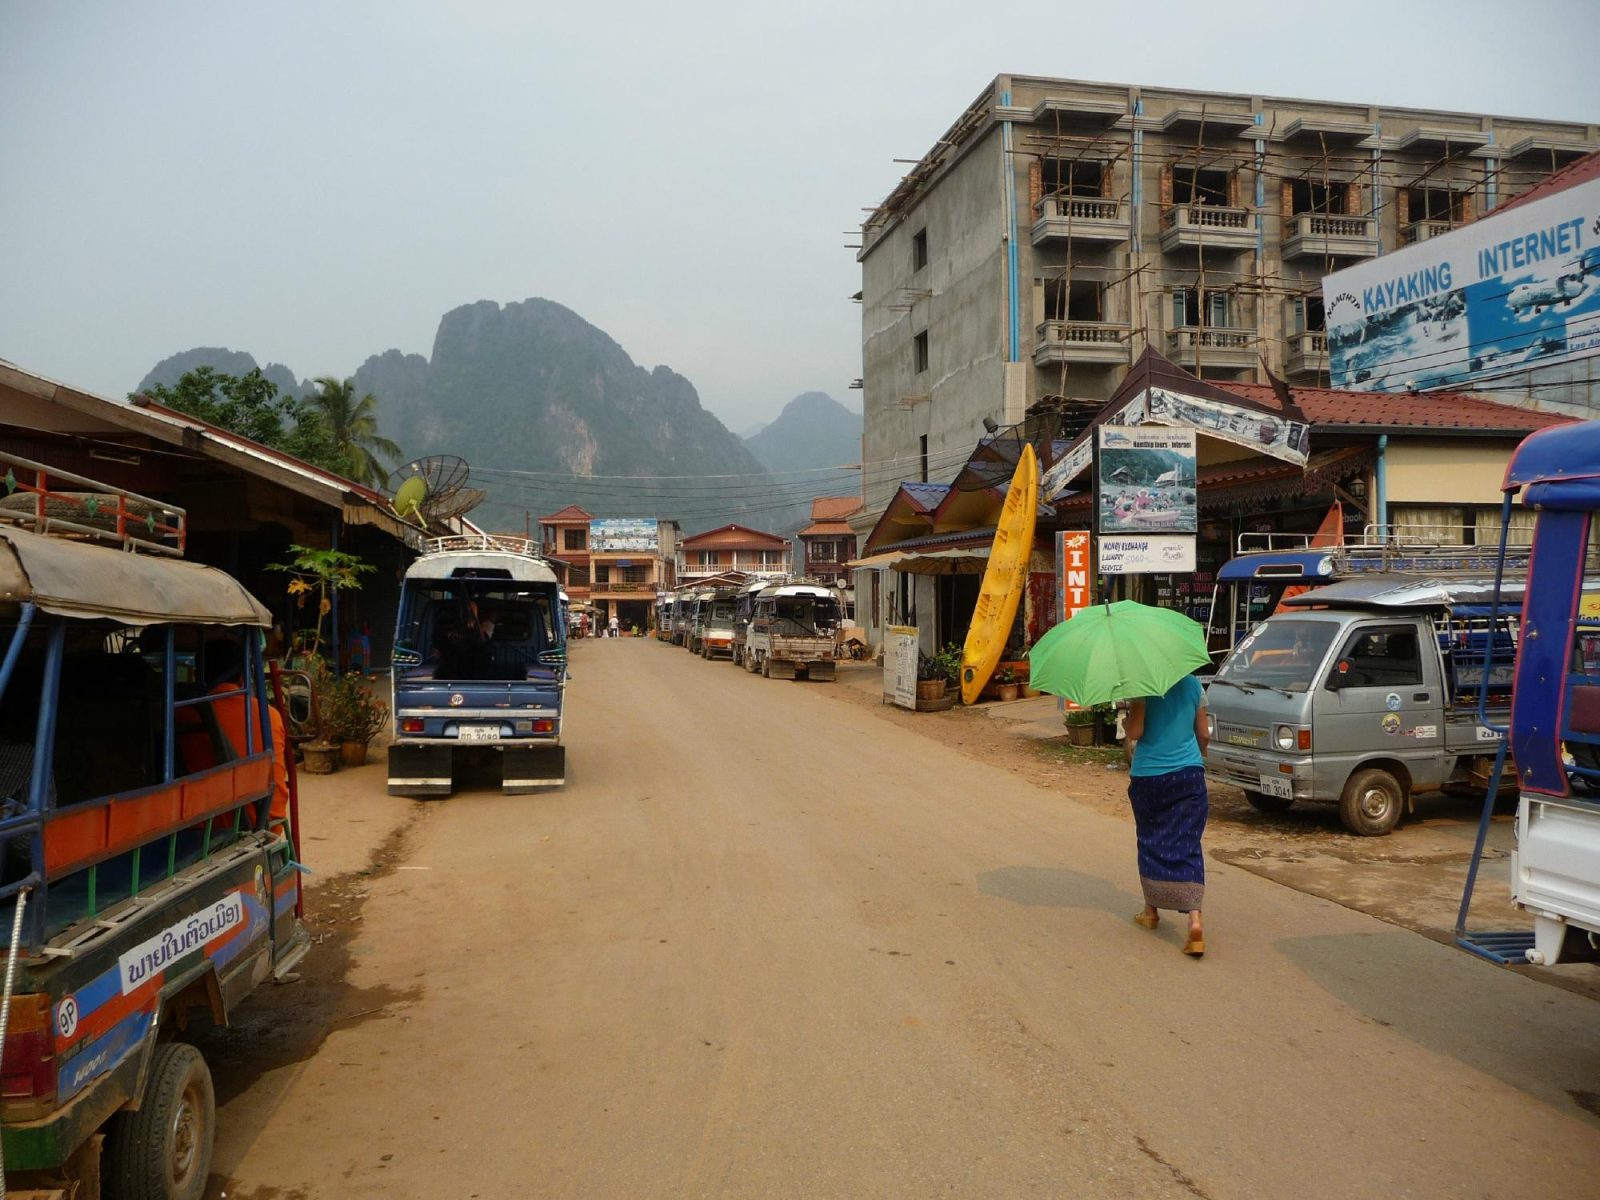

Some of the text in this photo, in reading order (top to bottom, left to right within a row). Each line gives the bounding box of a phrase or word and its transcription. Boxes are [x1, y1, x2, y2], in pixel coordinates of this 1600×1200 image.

[1478, 217, 1585, 279] INTERNET
[1363, 262, 1452, 314] KAYAKING
[1210, 626, 1228, 635] Card
[1273, 785, 1291, 798] 3041
[60, 1002, 75, 1034] 9P
